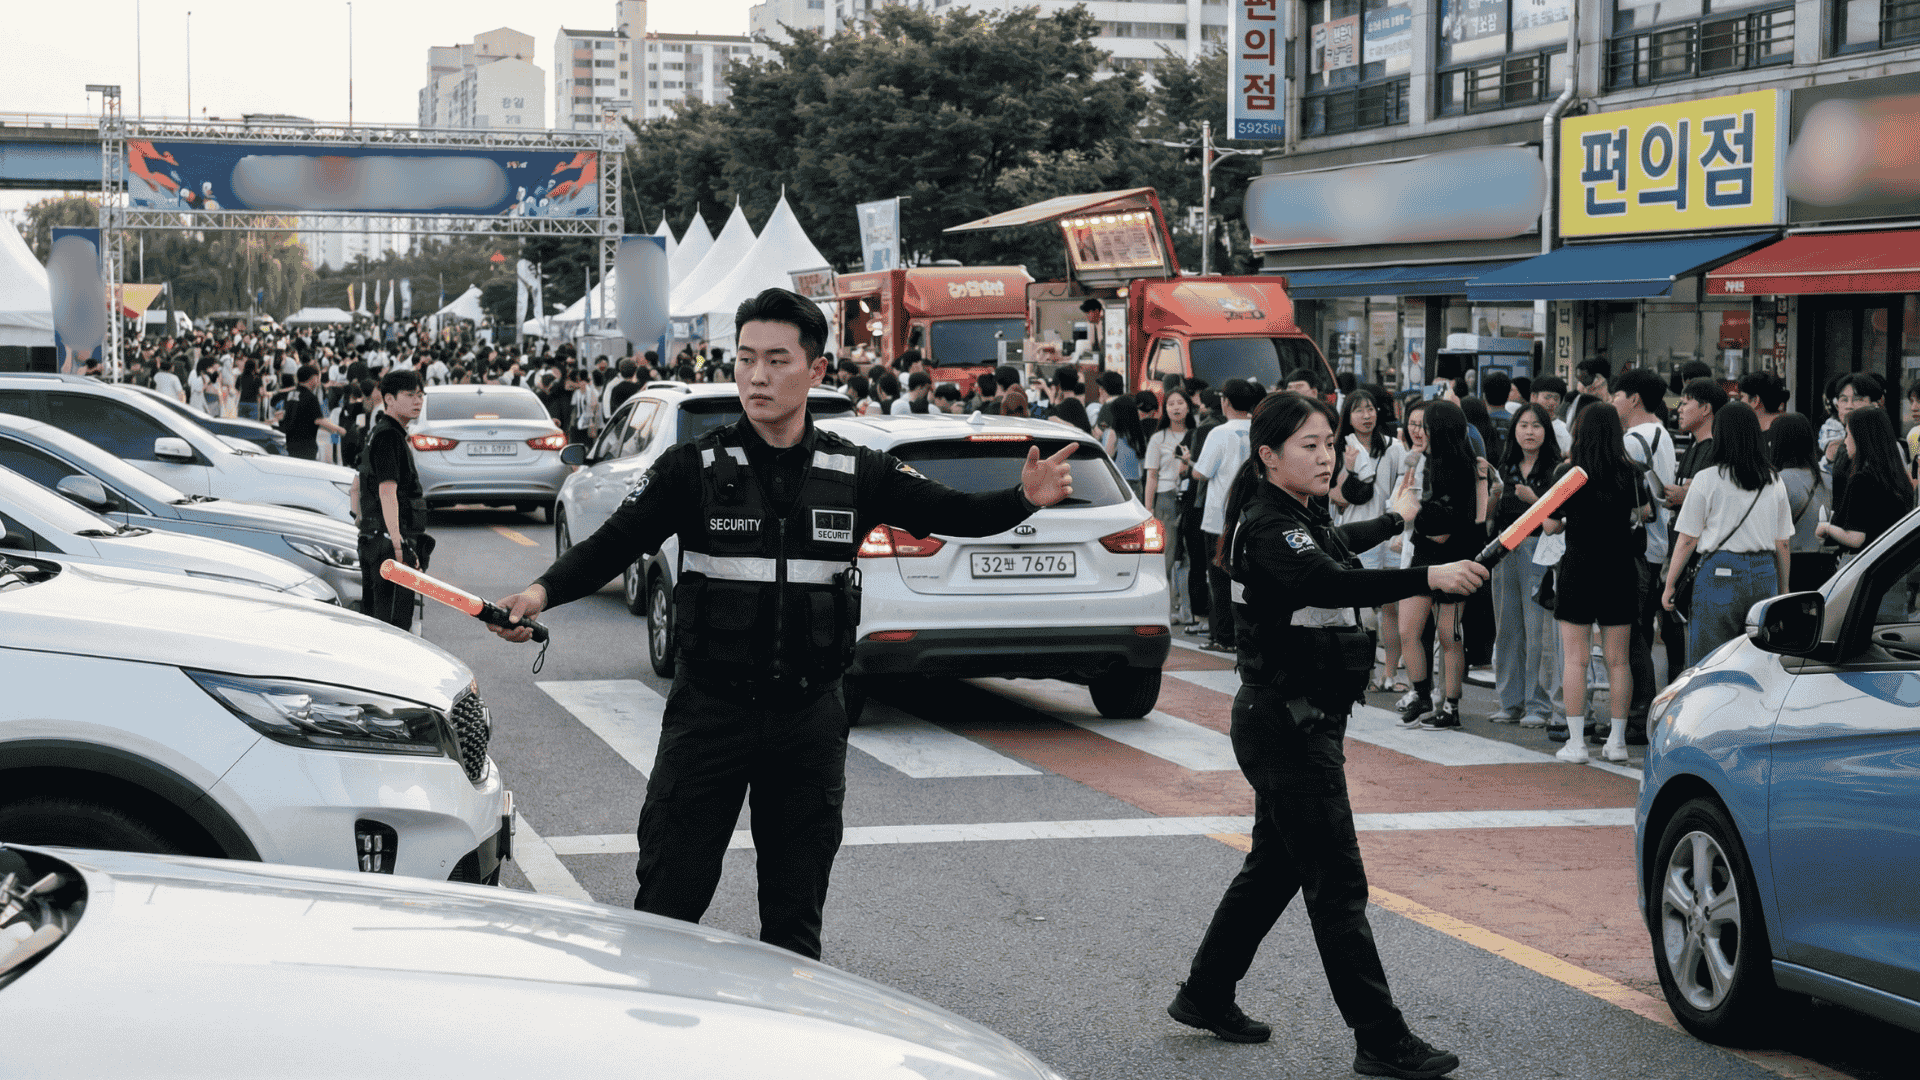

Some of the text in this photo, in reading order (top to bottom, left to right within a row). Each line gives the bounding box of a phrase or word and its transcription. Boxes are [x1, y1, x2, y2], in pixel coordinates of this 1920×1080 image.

[1581, 111, 1754, 216] 편의점
[709, 518, 761, 531] SECURITY
[818, 530, 850, 540] SECURIT
[1022, 556, 1067, 572] 7676
